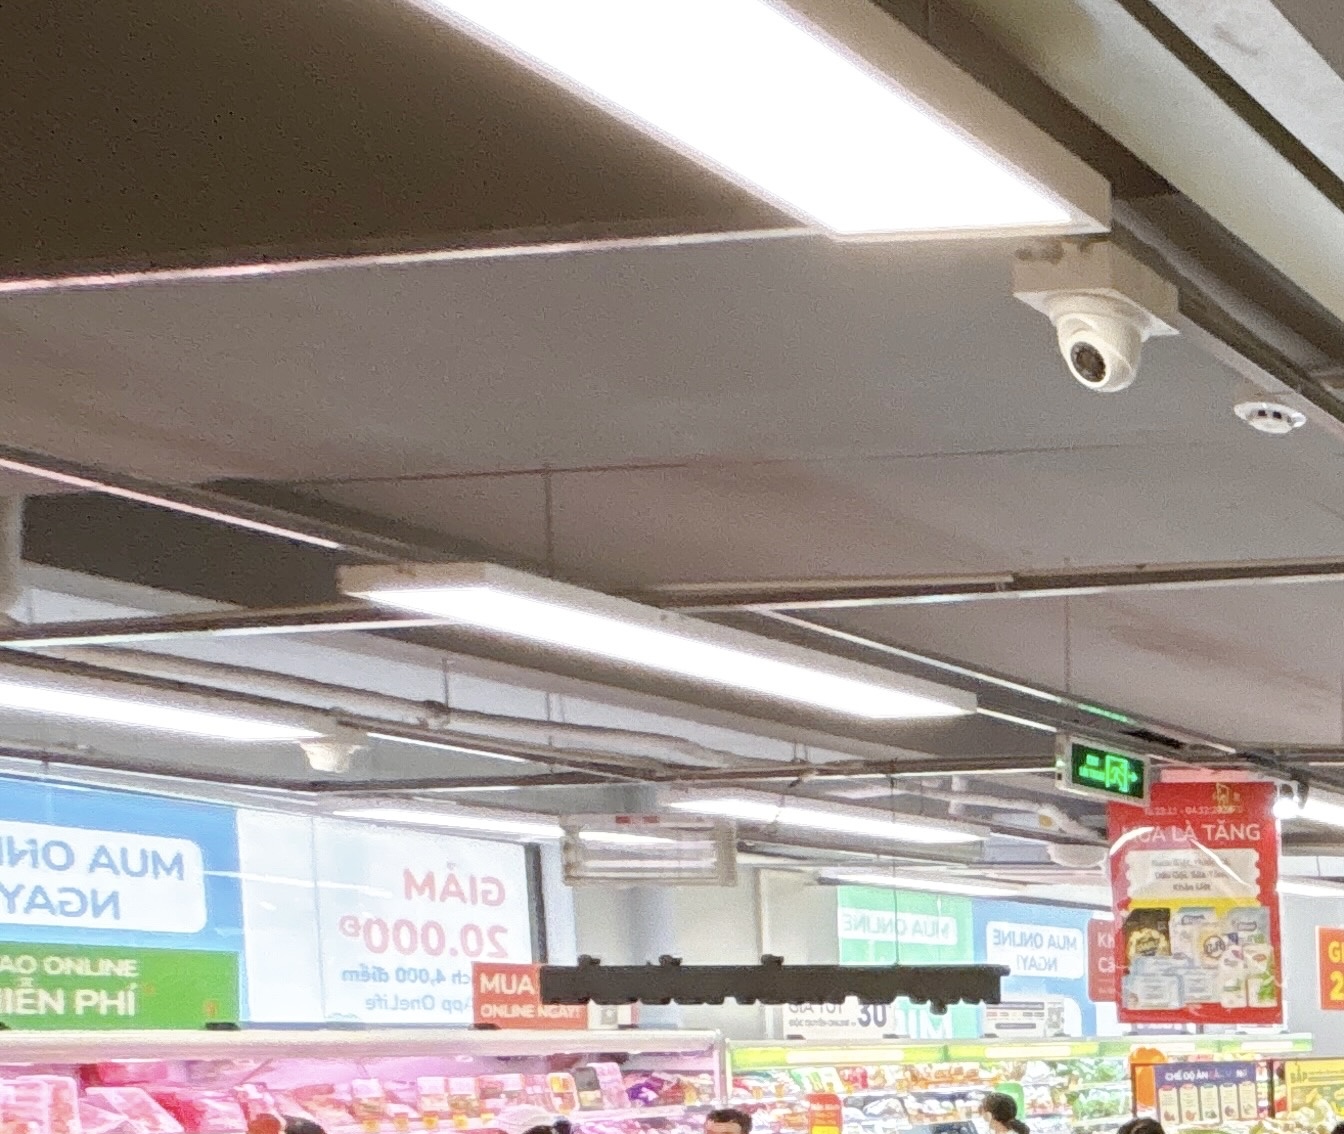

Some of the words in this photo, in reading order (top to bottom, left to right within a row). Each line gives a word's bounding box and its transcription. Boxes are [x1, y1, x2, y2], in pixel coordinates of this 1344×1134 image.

[1122, 826, 1166, 842] UA
[43, 955, 140, 977] ONLINE
[479, 972, 537, 996] MUA
[0, 975, 65, 1016] IỄN
[75, 982, 138, 1017] PHÍ
[480, 1003, 536, 1018] ONLINE
